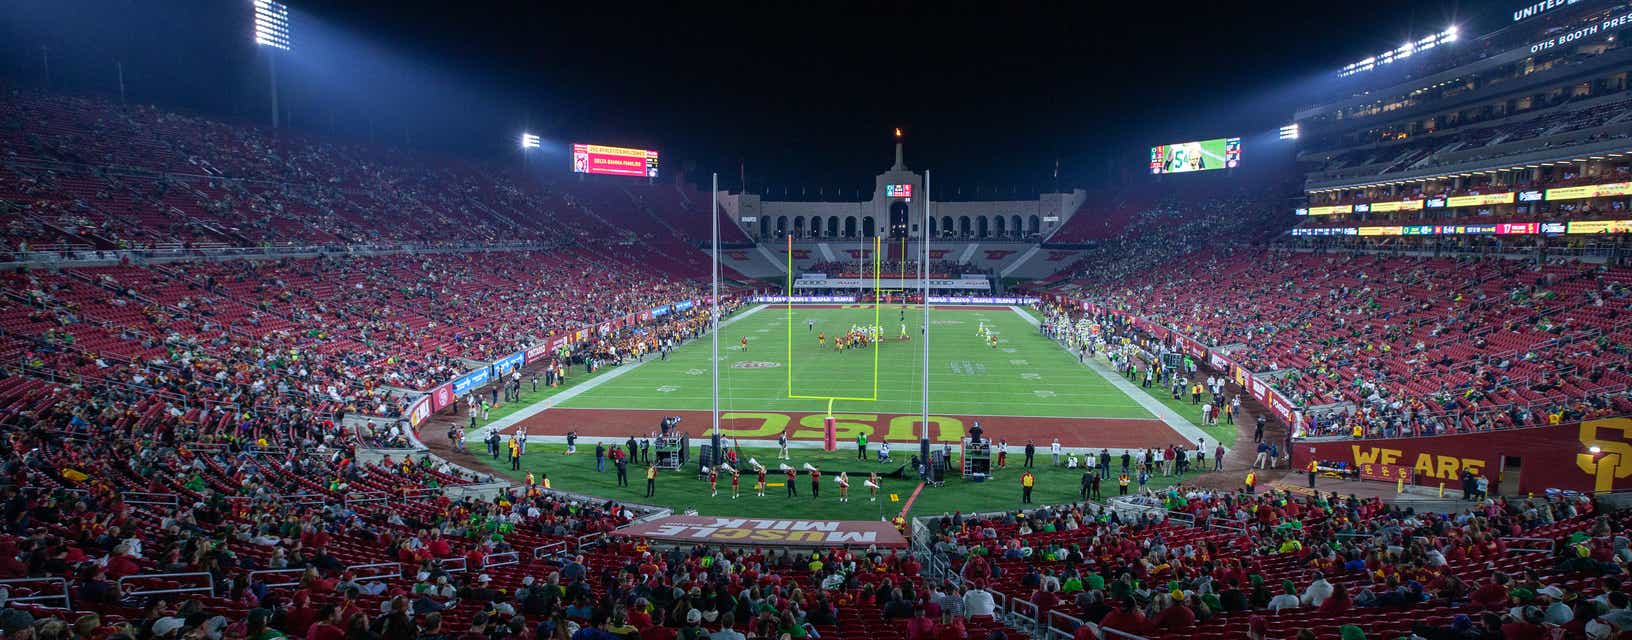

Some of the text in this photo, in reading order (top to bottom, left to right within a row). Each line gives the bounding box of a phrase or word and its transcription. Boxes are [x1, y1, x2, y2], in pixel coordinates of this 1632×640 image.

[1514, 0, 1565, 21] UNITED
[1530, 39, 1555, 53] OTIS
[1558, 25, 1598, 45] BOOTH
[703, 413, 966, 440] USC
[1351, 445, 1486, 480] WE ARE
[644, 525, 877, 542] MUSCLE
[708, 518, 840, 531] MILK
